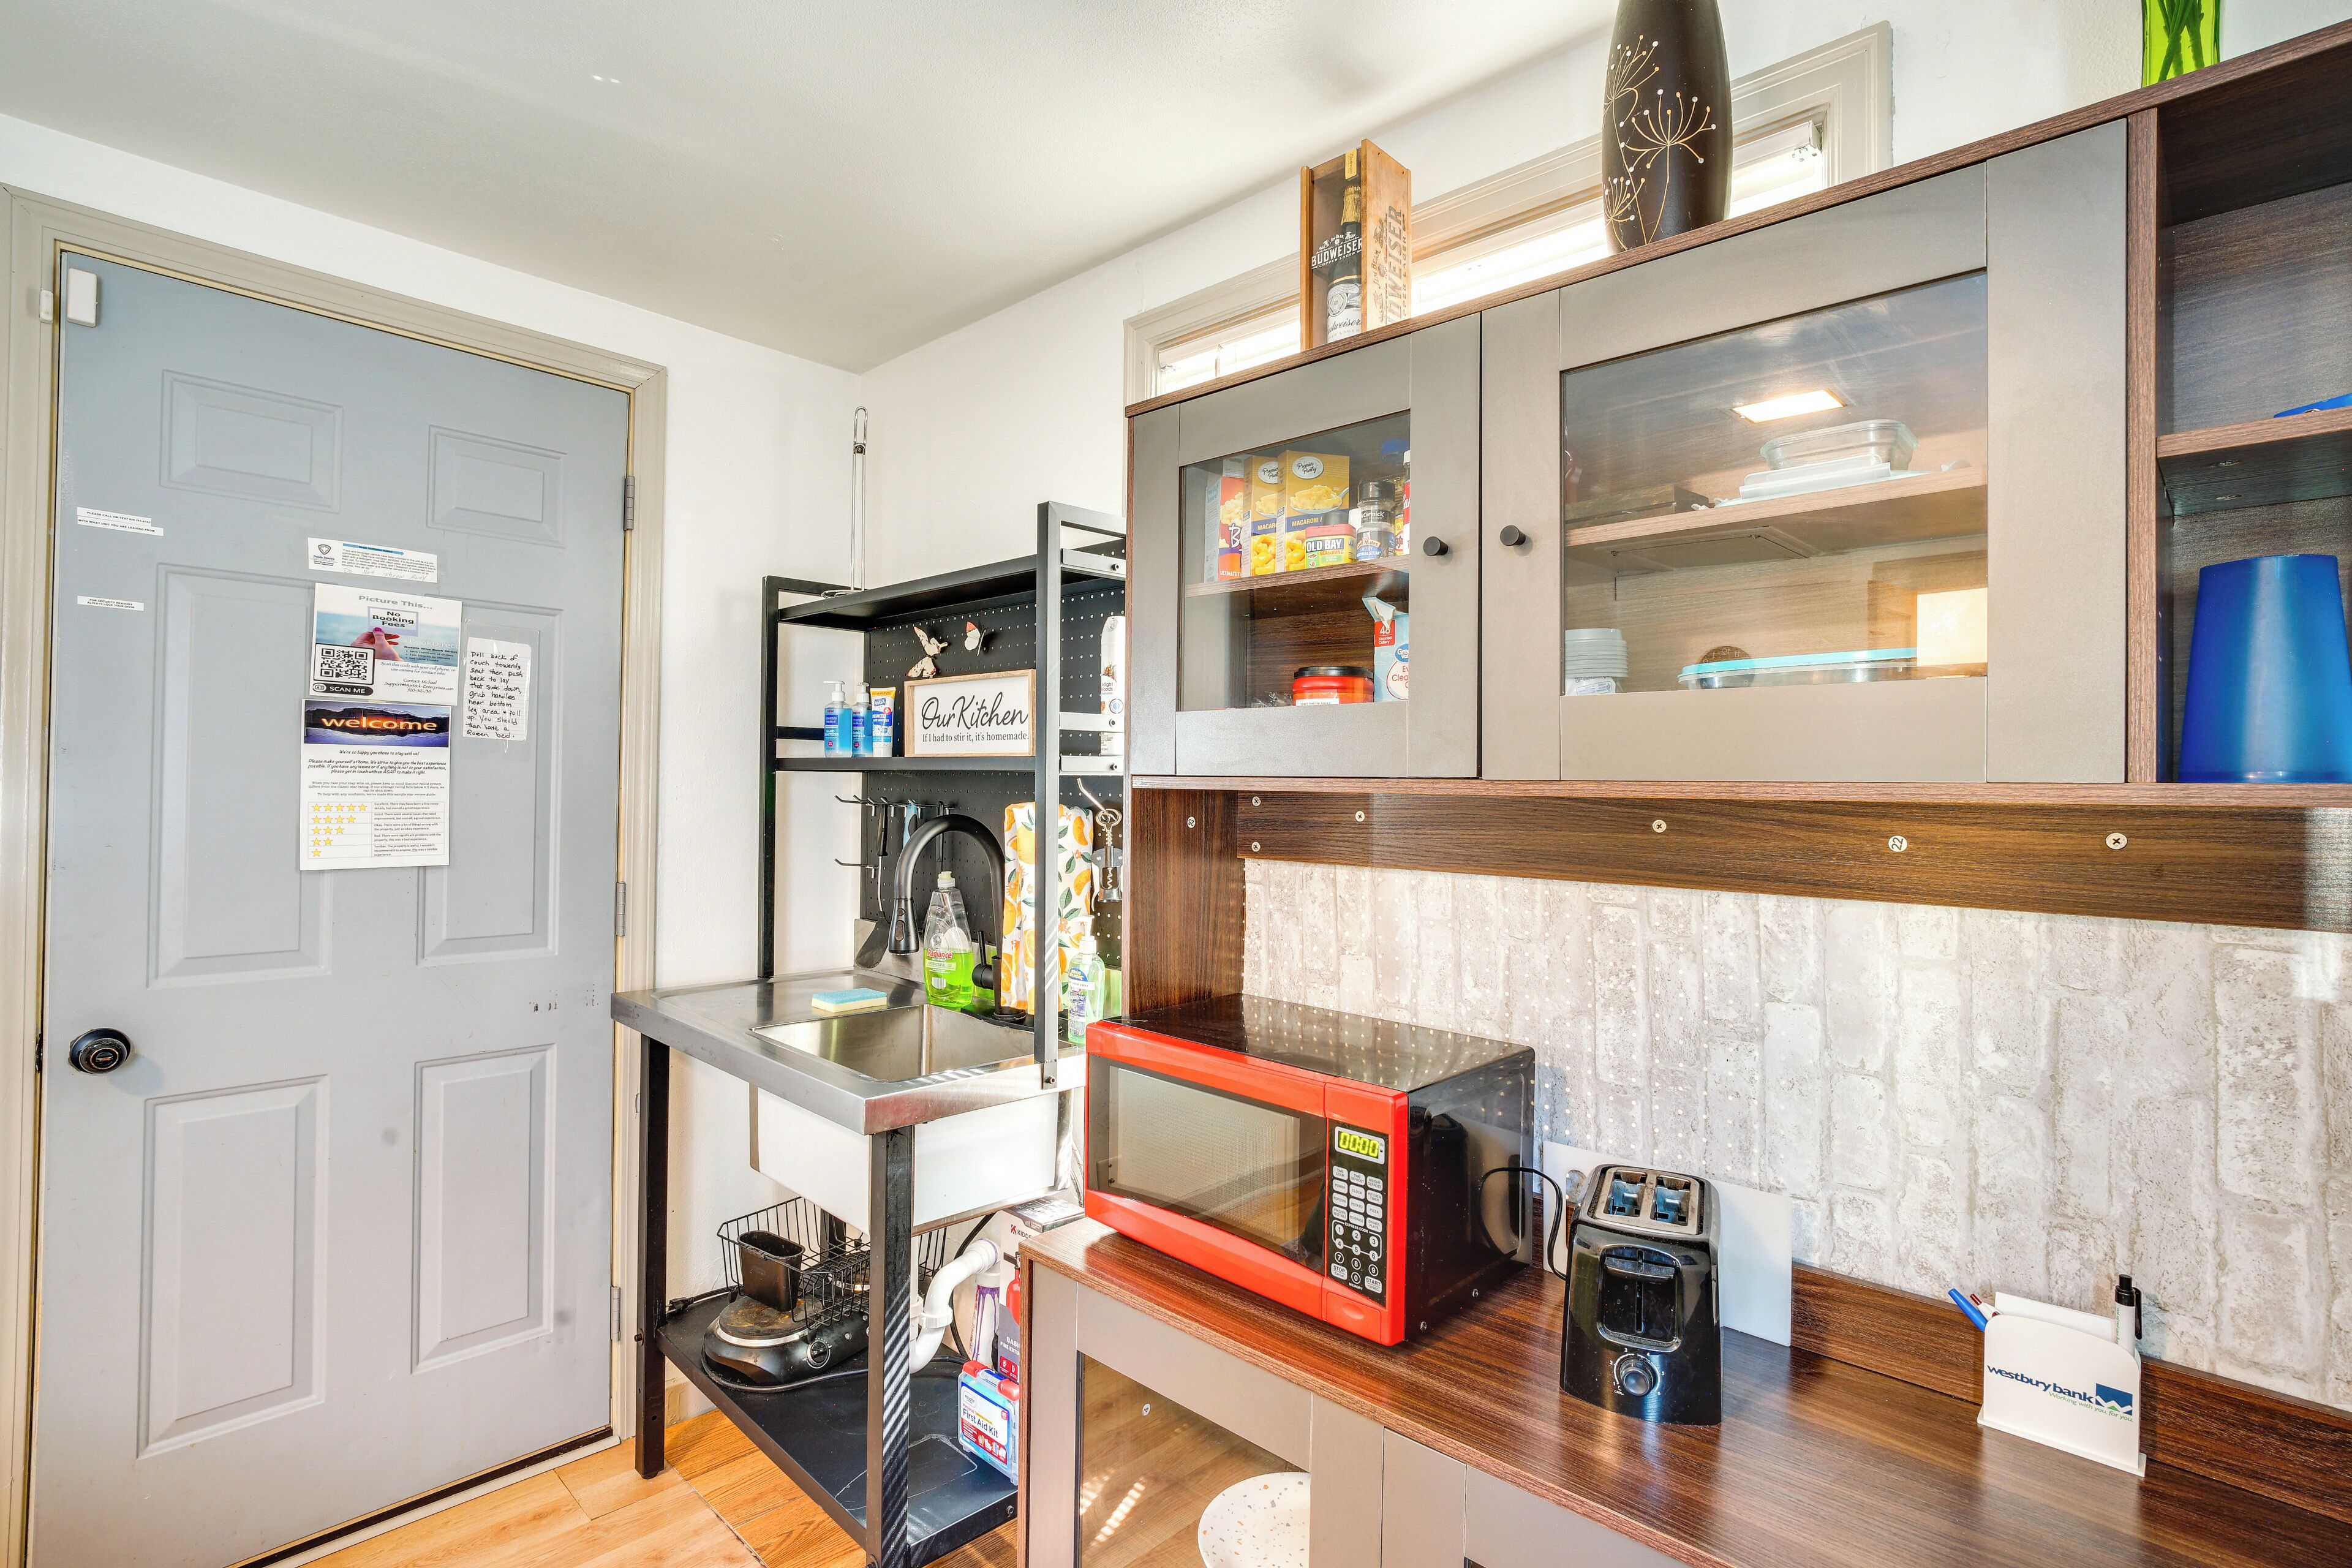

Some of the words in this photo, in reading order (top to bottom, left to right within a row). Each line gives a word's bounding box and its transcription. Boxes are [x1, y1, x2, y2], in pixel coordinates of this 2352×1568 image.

[1311, 238, 1362, 267] BUDWEISER
[1319, 258, 1338, 267] COPPER
[1340, 252, 1355, 260] LAGER
[1371, 250, 1381, 270] BEAM
[1388, 205, 1402, 323] DWEISER
[1328, 318, 1361, 334] udweiser
[1297, 461, 1314, 470] Premier
[1257, 522, 1276, 531] MACAR
[1292, 517, 1319, 527] MACARONI
[1306, 540, 1322, 552] OLD
[358, 595, 398, 605] Picture
[401, 600, 433, 609] This...
[372, 614, 414, 625] Booking
[494, 661, 521, 670] towards
[491, 691, 516, 701] handles
[468, 706, 478, 715] leg
[922, 696, 955, 729] Our
[952, 692, 1029, 729] Kitchen
[321, 717, 437, 731] welcome
[479, 715, 492, 723] You
[923, 733, 929, 742] If
[933, 733, 944, 742] had
[954, 733, 965, 742] stir
[976, 732, 985, 741] it's
[986, 731, 1029, 741] homemade.
[927, 948, 953, 959] Radiance
[1338, 1132, 1379, 1158] 00:00
[1333, 1196, 1348, 1204] POPCORN
[1344, 1222, 1359, 1231] EXPRESS
[1349, 1282, 1363, 1291] MEMORY
[1366, 1277, 1381, 1287] START
[1000, 1341, 1009, 1351] FIRE
[1987, 1365, 2052, 1392] westbury
[2053, 1383, 2094, 1404] bank
[2049, 1392, 2077, 1406] Working
[2078, 1401, 2094, 1410] with
[2108, 1409, 2119, 1418] for
[963, 1408, 976, 1423] First
[977, 1419, 987, 1431] Aid
[989, 1426, 998, 1439] Kit
